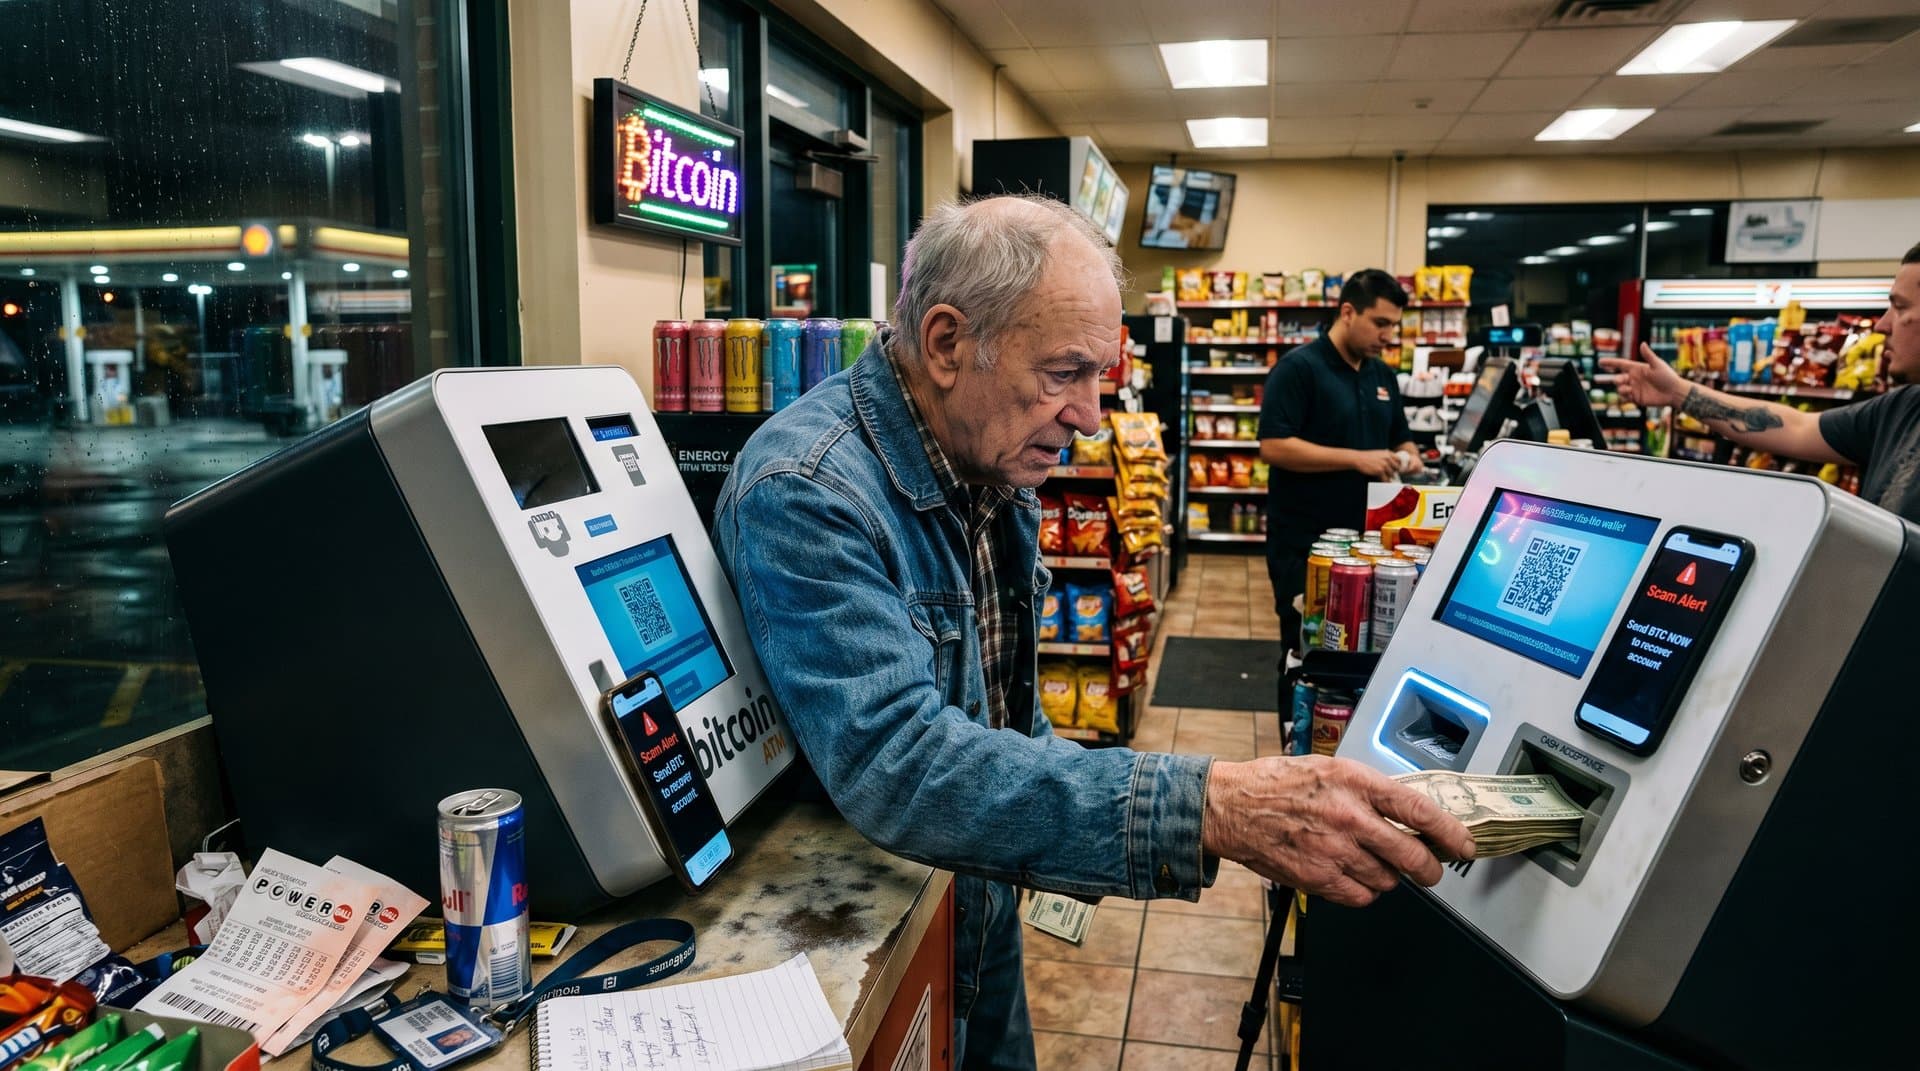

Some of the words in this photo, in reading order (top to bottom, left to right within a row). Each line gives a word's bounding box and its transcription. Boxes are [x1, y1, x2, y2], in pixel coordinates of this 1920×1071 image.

[618, 114, 737, 213] Bitcoin
[679, 450, 729, 461] ENERGY
[1647, 585, 1677, 603] Scam
[1677, 593, 1707, 612] Alert
[1626, 619, 1650, 634] Send
[1648, 626, 1668, 640] BTC
[1666, 632, 1693, 648] NOW
[1631, 637, 1641, 647] to
[1640, 641, 1673, 658] recover
[1627, 652, 1662, 670] account
[687, 686, 776, 779] bitcoin
[1540, 735, 1560, 750] CASH
[640, 745, 663, 765] Scam
[661, 732, 679, 750] Alert
[763, 730, 786, 765] ATM
[653, 762, 673, 783] Send
[670, 754, 685, 771] BTC
[661, 787, 671, 799] to
[669, 771, 692, 793] recover
[442, 889, 464, 912] ull
